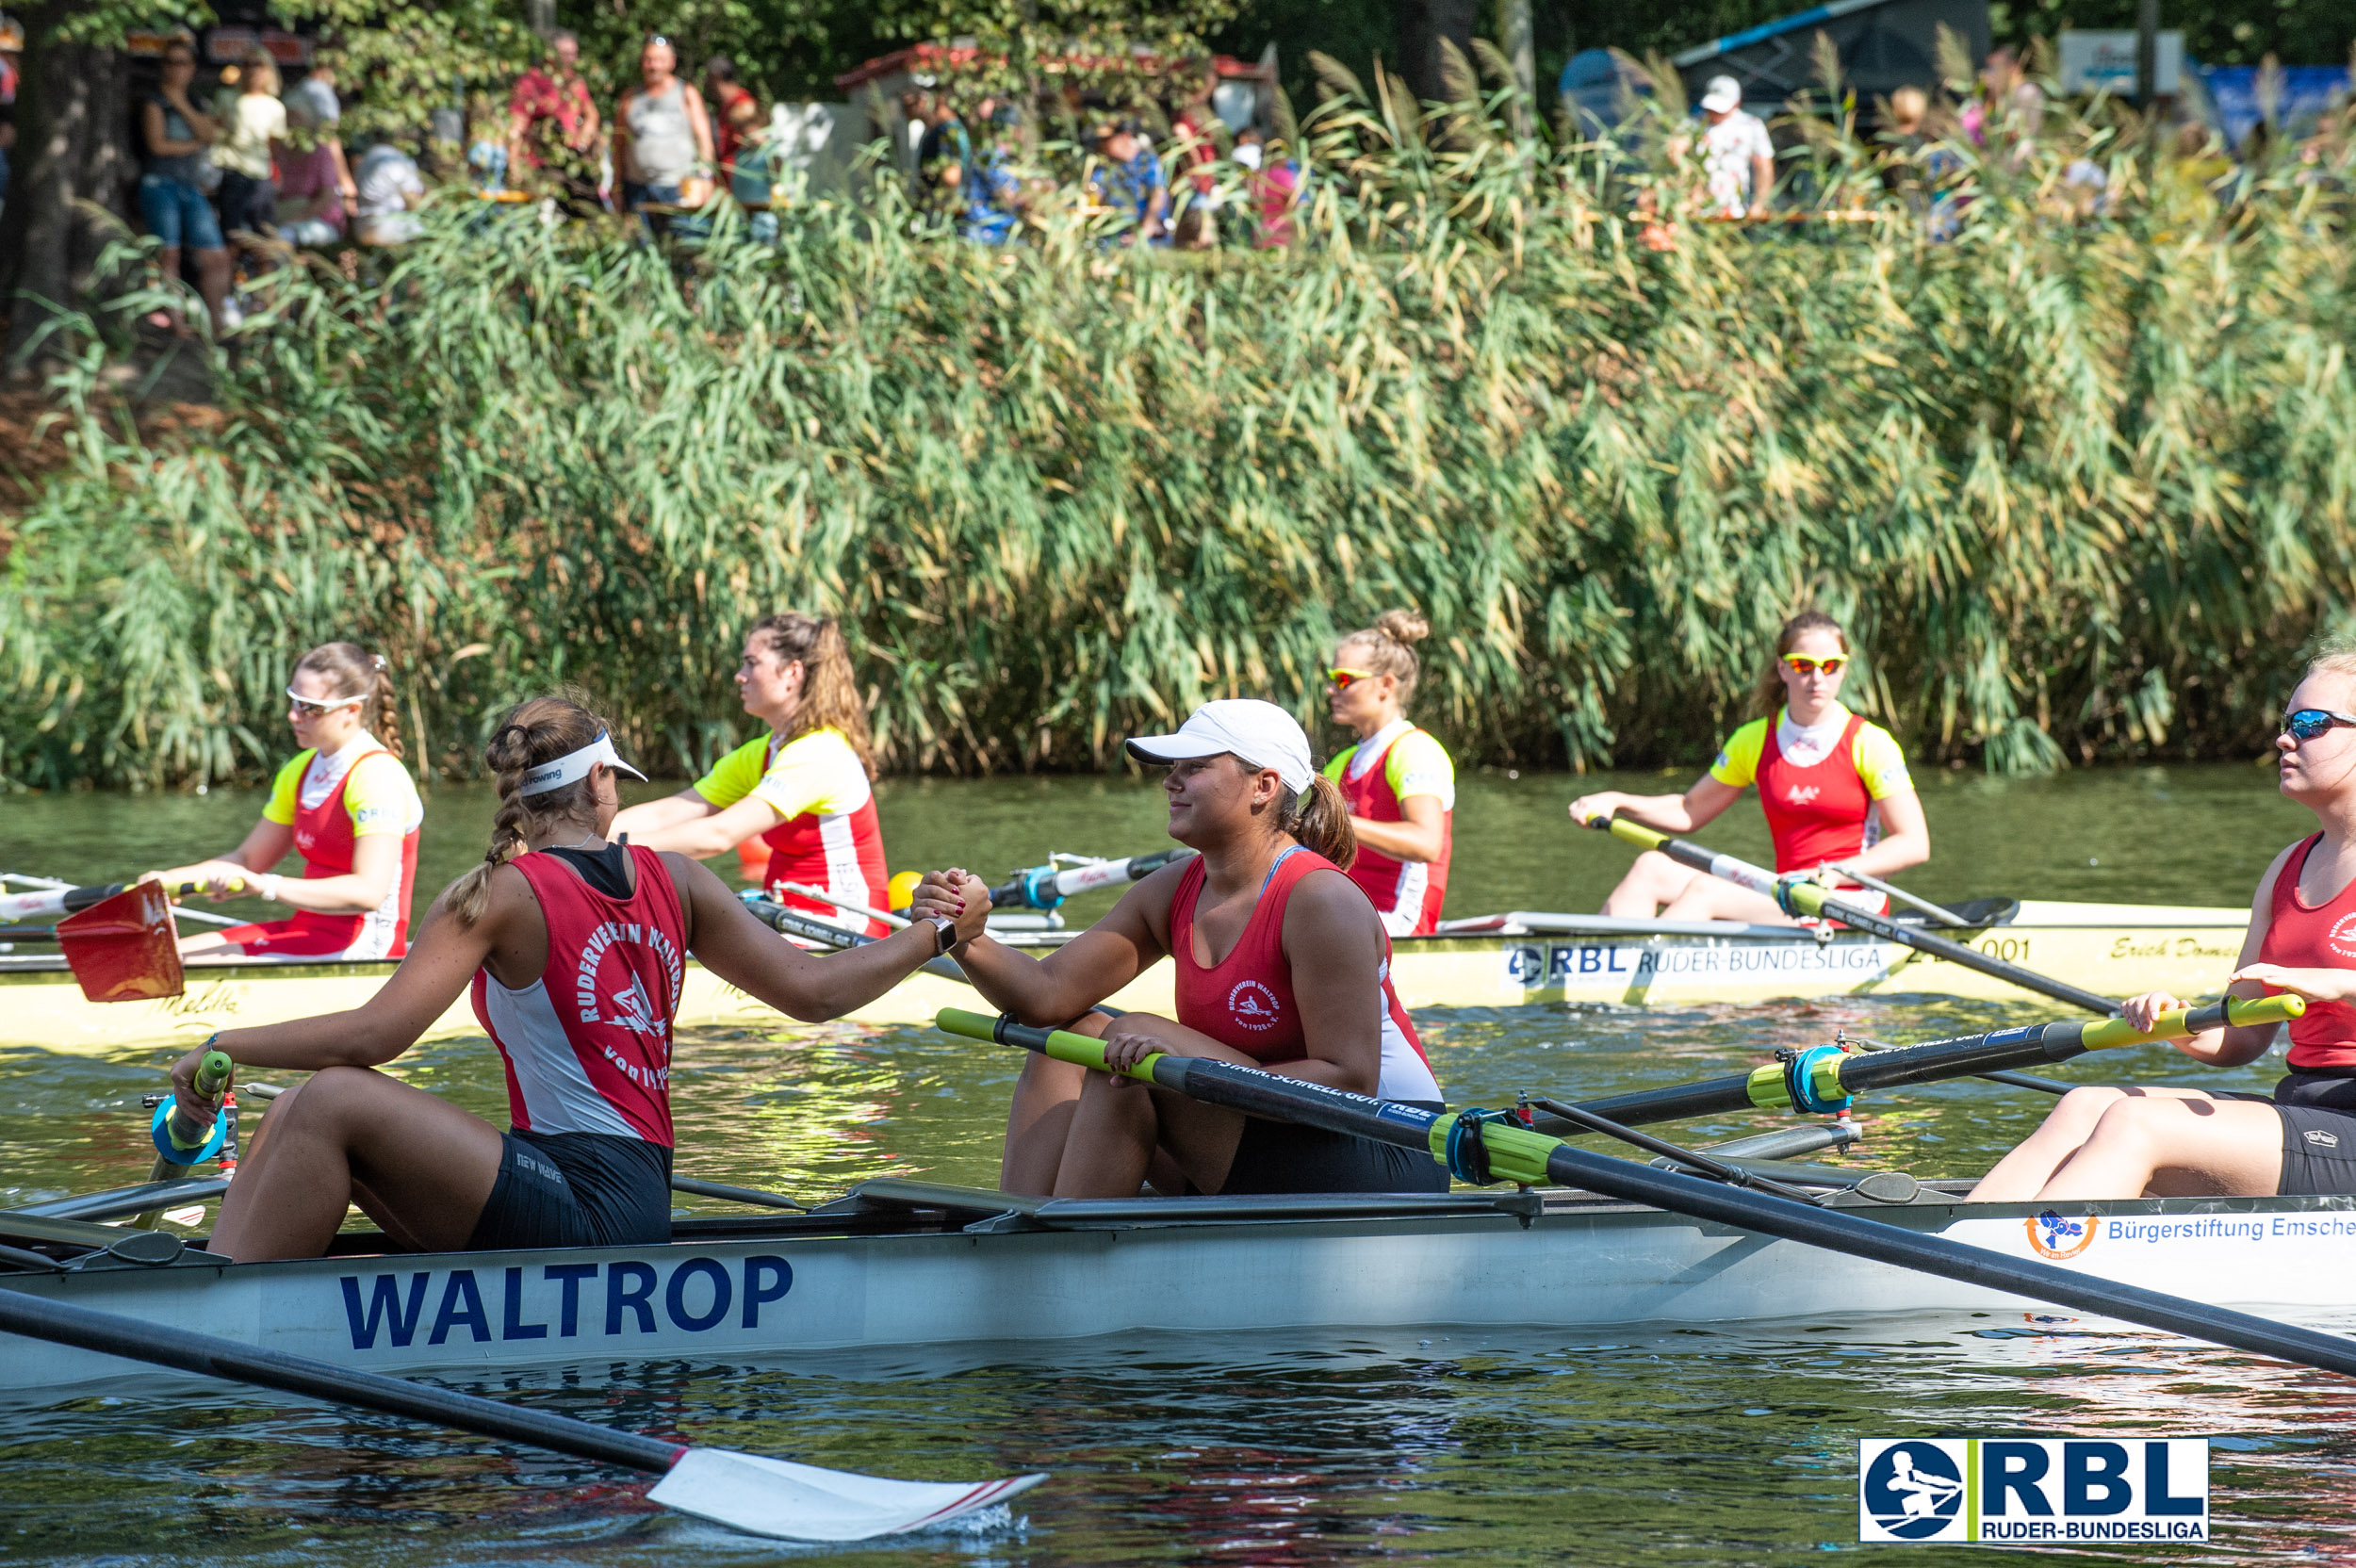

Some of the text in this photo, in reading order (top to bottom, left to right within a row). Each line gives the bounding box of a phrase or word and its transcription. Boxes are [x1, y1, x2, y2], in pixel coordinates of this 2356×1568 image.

[530, 769, 562, 785] rowing
[1550, 946, 1627, 973] RBL
[1639, 948, 1881, 974] RUDER-BUNDESLIGA
[1229, 980, 1280, 1011] RUDERVEREIN WALTROP
[1235, 1017, 1248, 1029] von
[603, 1044, 639, 1081] von
[516, 1152, 562, 1184] NEW WAVE
[2108, 1218, 2264, 1244] Bürgerstiftung
[339, 1255, 794, 1351] WALTROP
